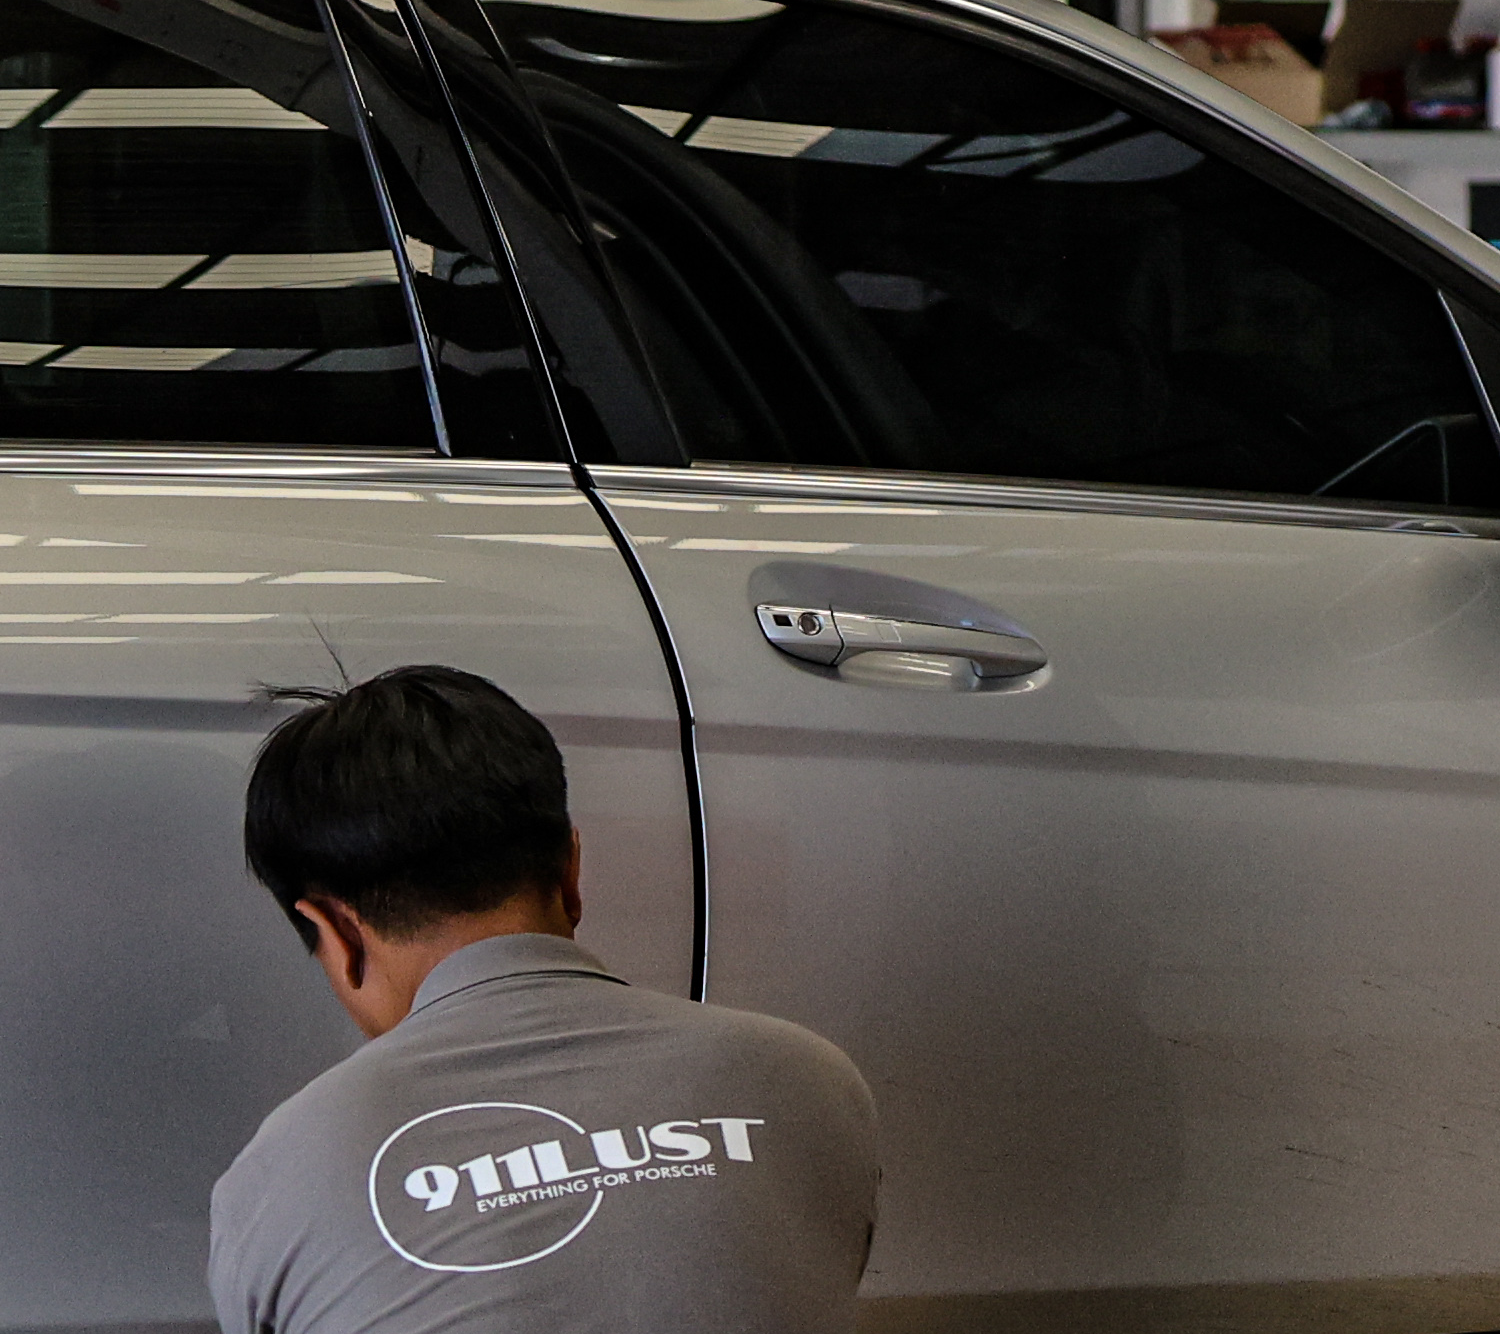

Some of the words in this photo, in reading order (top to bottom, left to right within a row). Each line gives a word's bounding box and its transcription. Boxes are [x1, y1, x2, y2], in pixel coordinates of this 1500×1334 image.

[404, 1119, 764, 1211] 911LUST
[476, 1178, 588, 1213] EVERYTHING
[592, 1172, 630, 1189] FOR
[634, 1163, 717, 1183] PORSCHE
